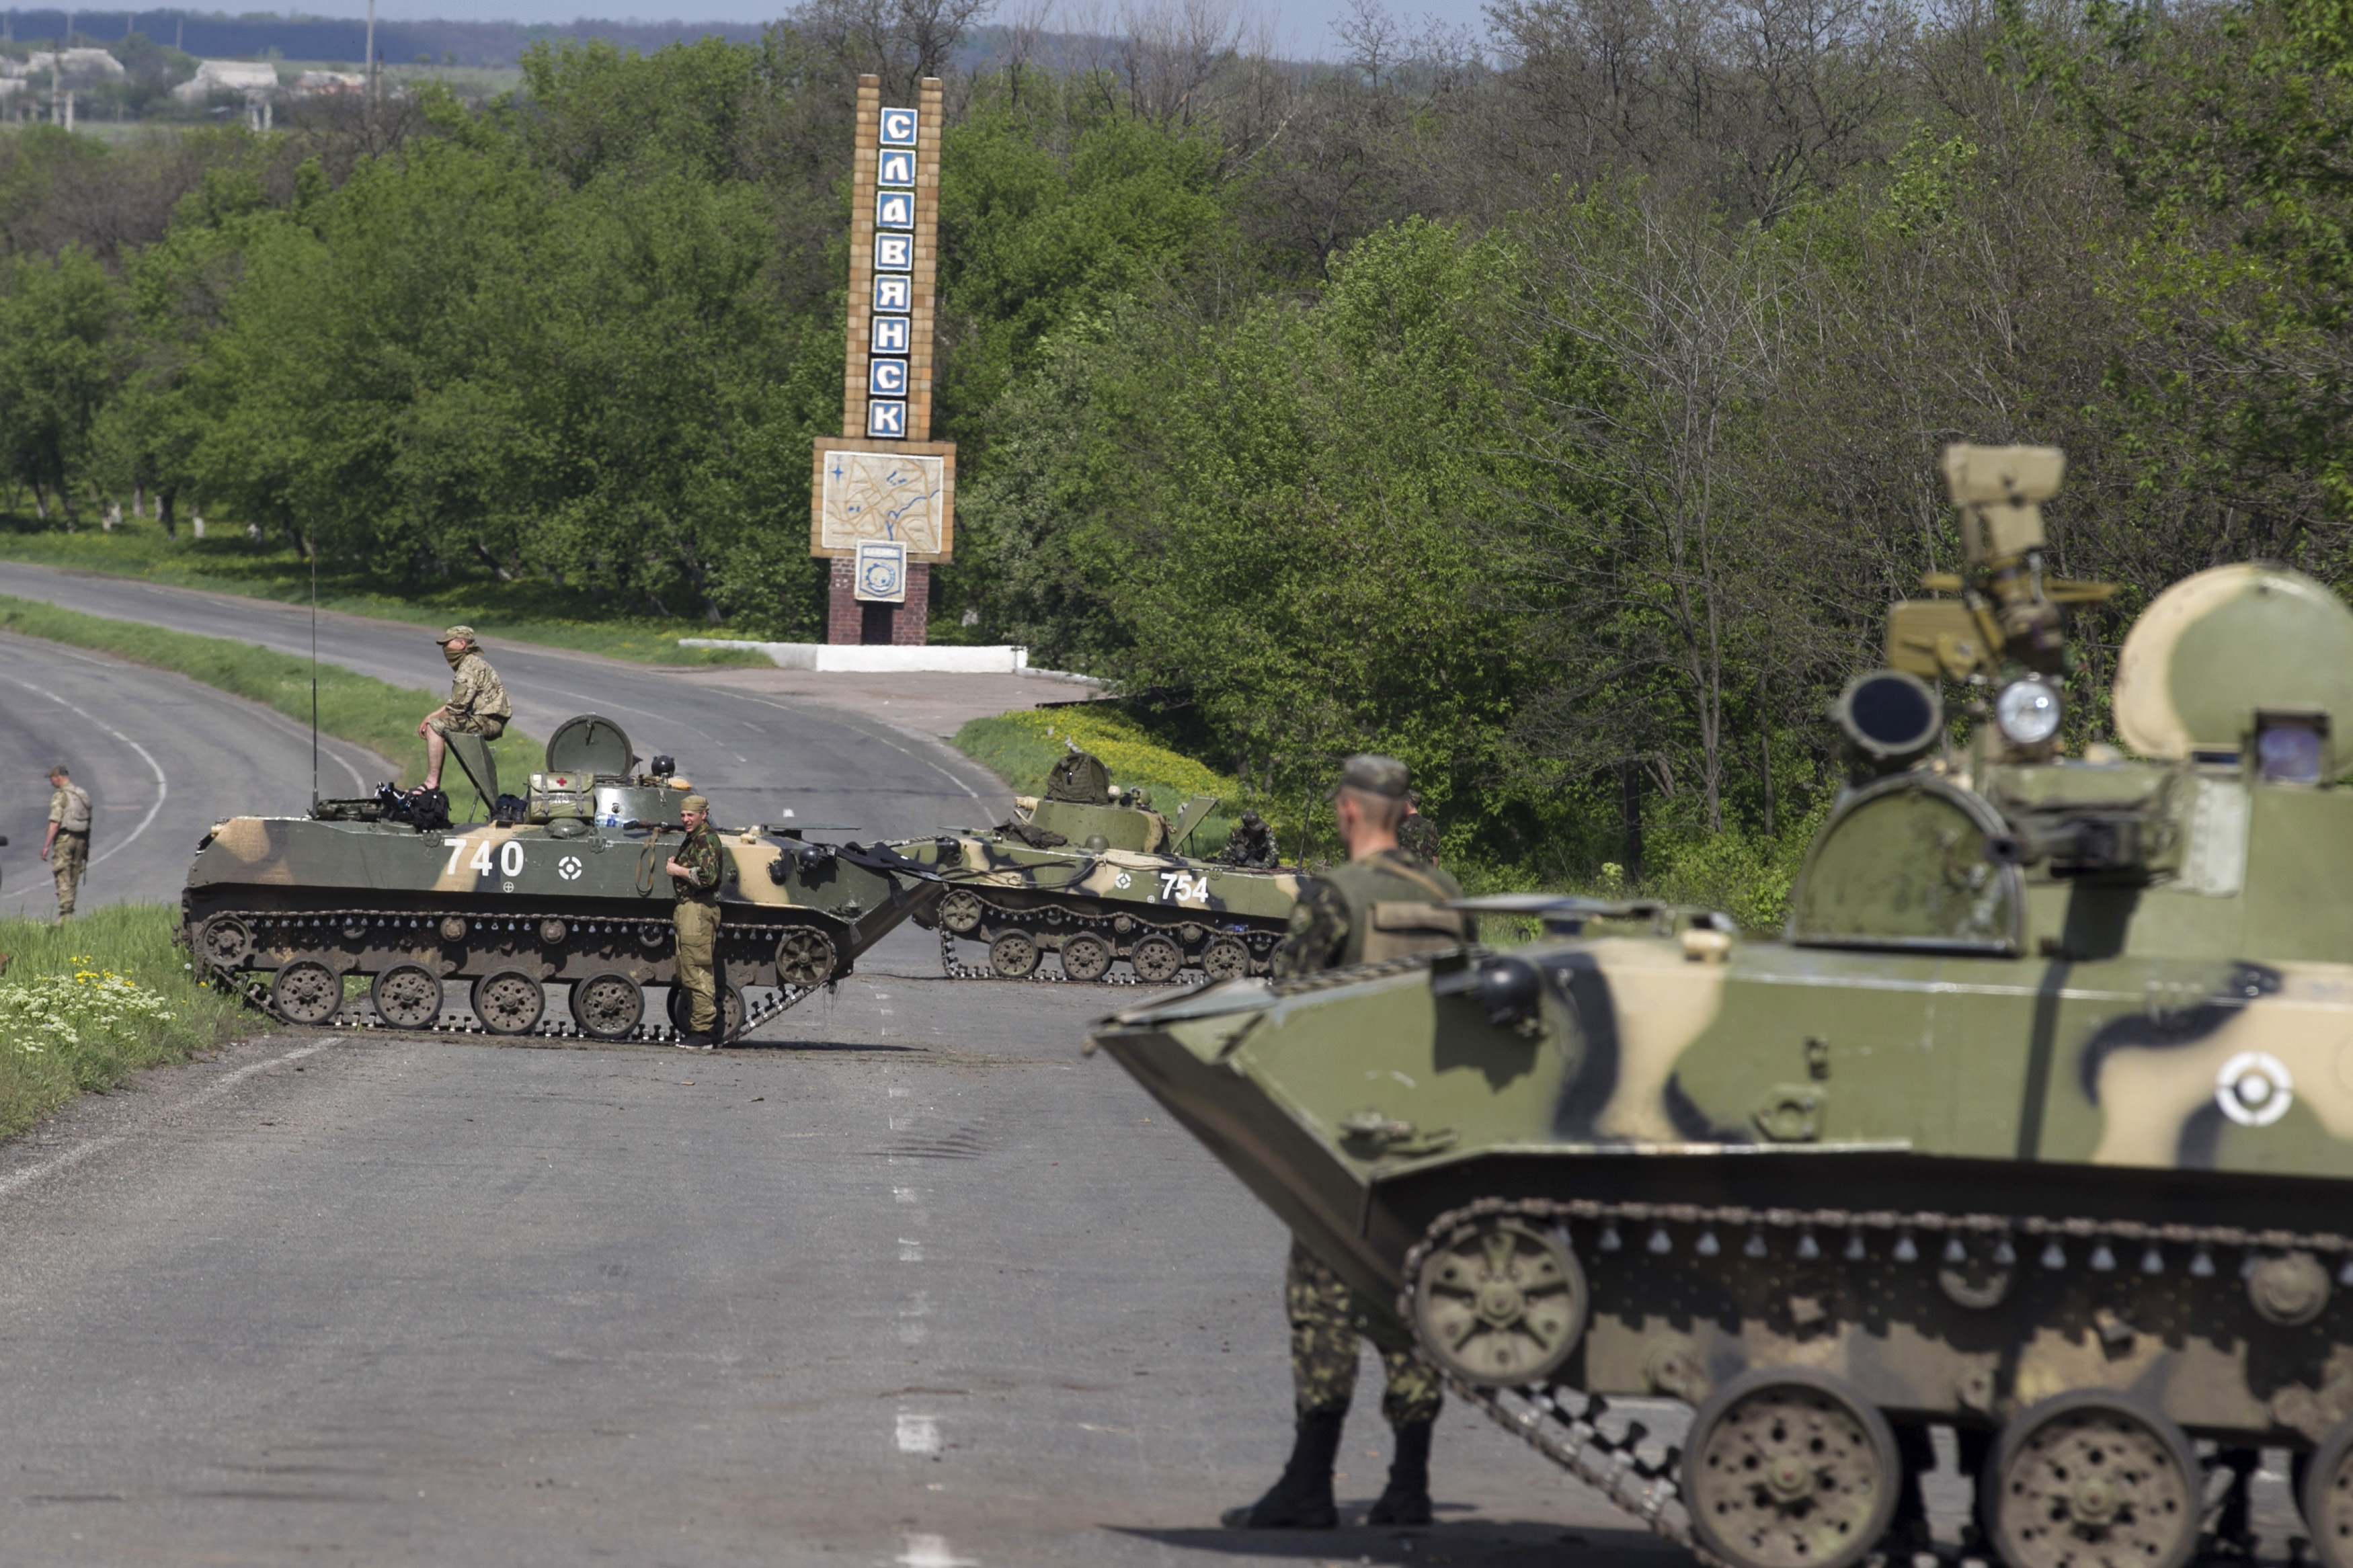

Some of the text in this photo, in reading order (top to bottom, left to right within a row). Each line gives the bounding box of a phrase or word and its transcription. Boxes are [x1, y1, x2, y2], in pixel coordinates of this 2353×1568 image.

[873, 114, 912, 431] СЛАВЯНСК
[444, 839, 524, 877] 740
[1160, 872, 1209, 903] 754
